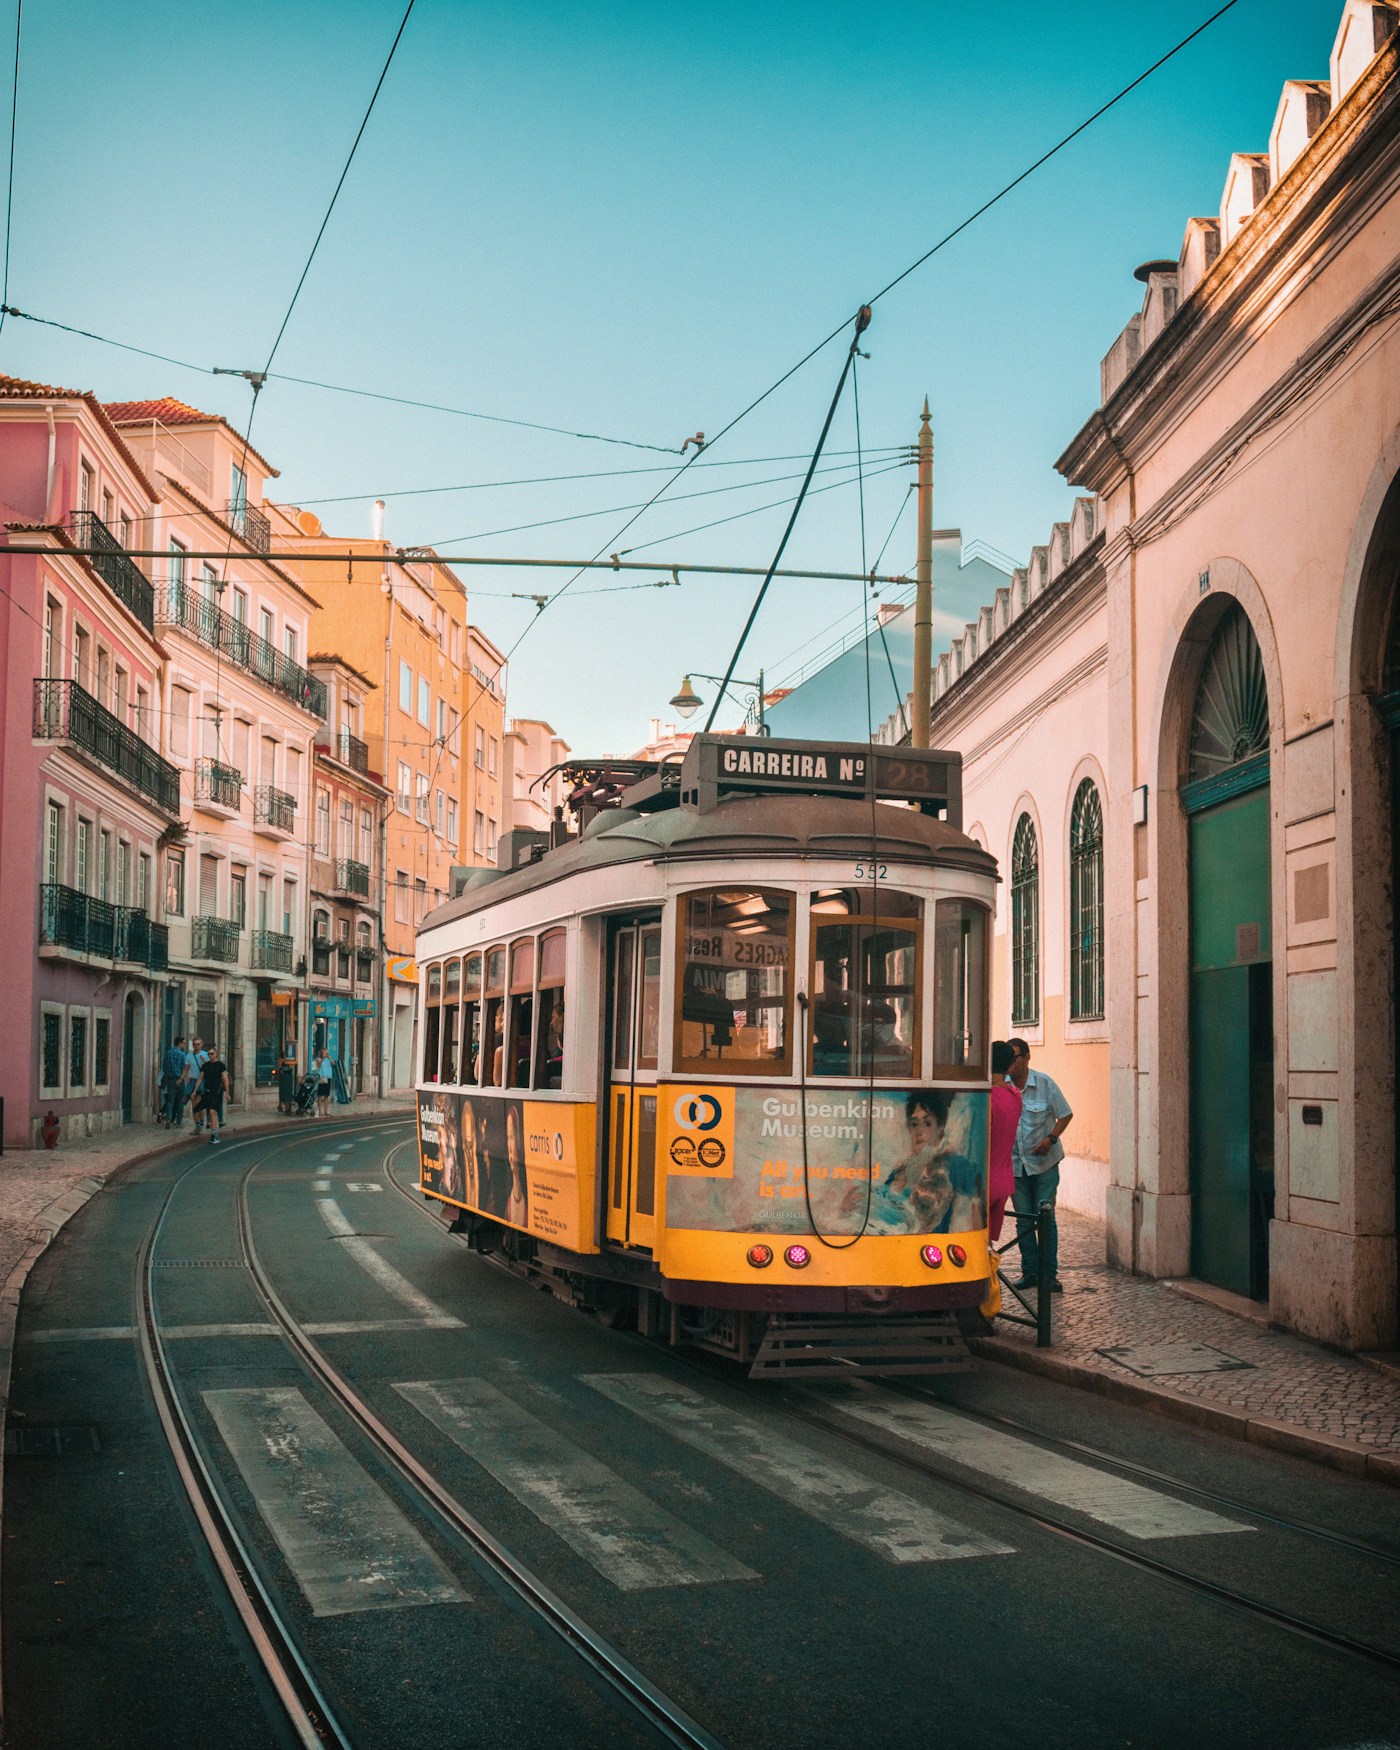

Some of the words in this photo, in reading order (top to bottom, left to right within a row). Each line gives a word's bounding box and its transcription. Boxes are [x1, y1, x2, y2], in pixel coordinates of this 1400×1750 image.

[724, 749, 828, 779] CARREIRA
[839, 758, 865, 781] Nº
[886, 761, 930, 789] 28
[854, 863, 887, 879] 552
[762, 1097, 895, 1119] Gulbenkian
[761, 1118, 864, 1139] Museum.
[529, 1129, 550, 1155] carris
[761, 1160, 788, 1178] All
[792, 1166, 828, 1182] you
[833, 1160, 881, 1180] need
[759, 1180, 775, 1198] is
[780, 1183, 815, 1199] art.
